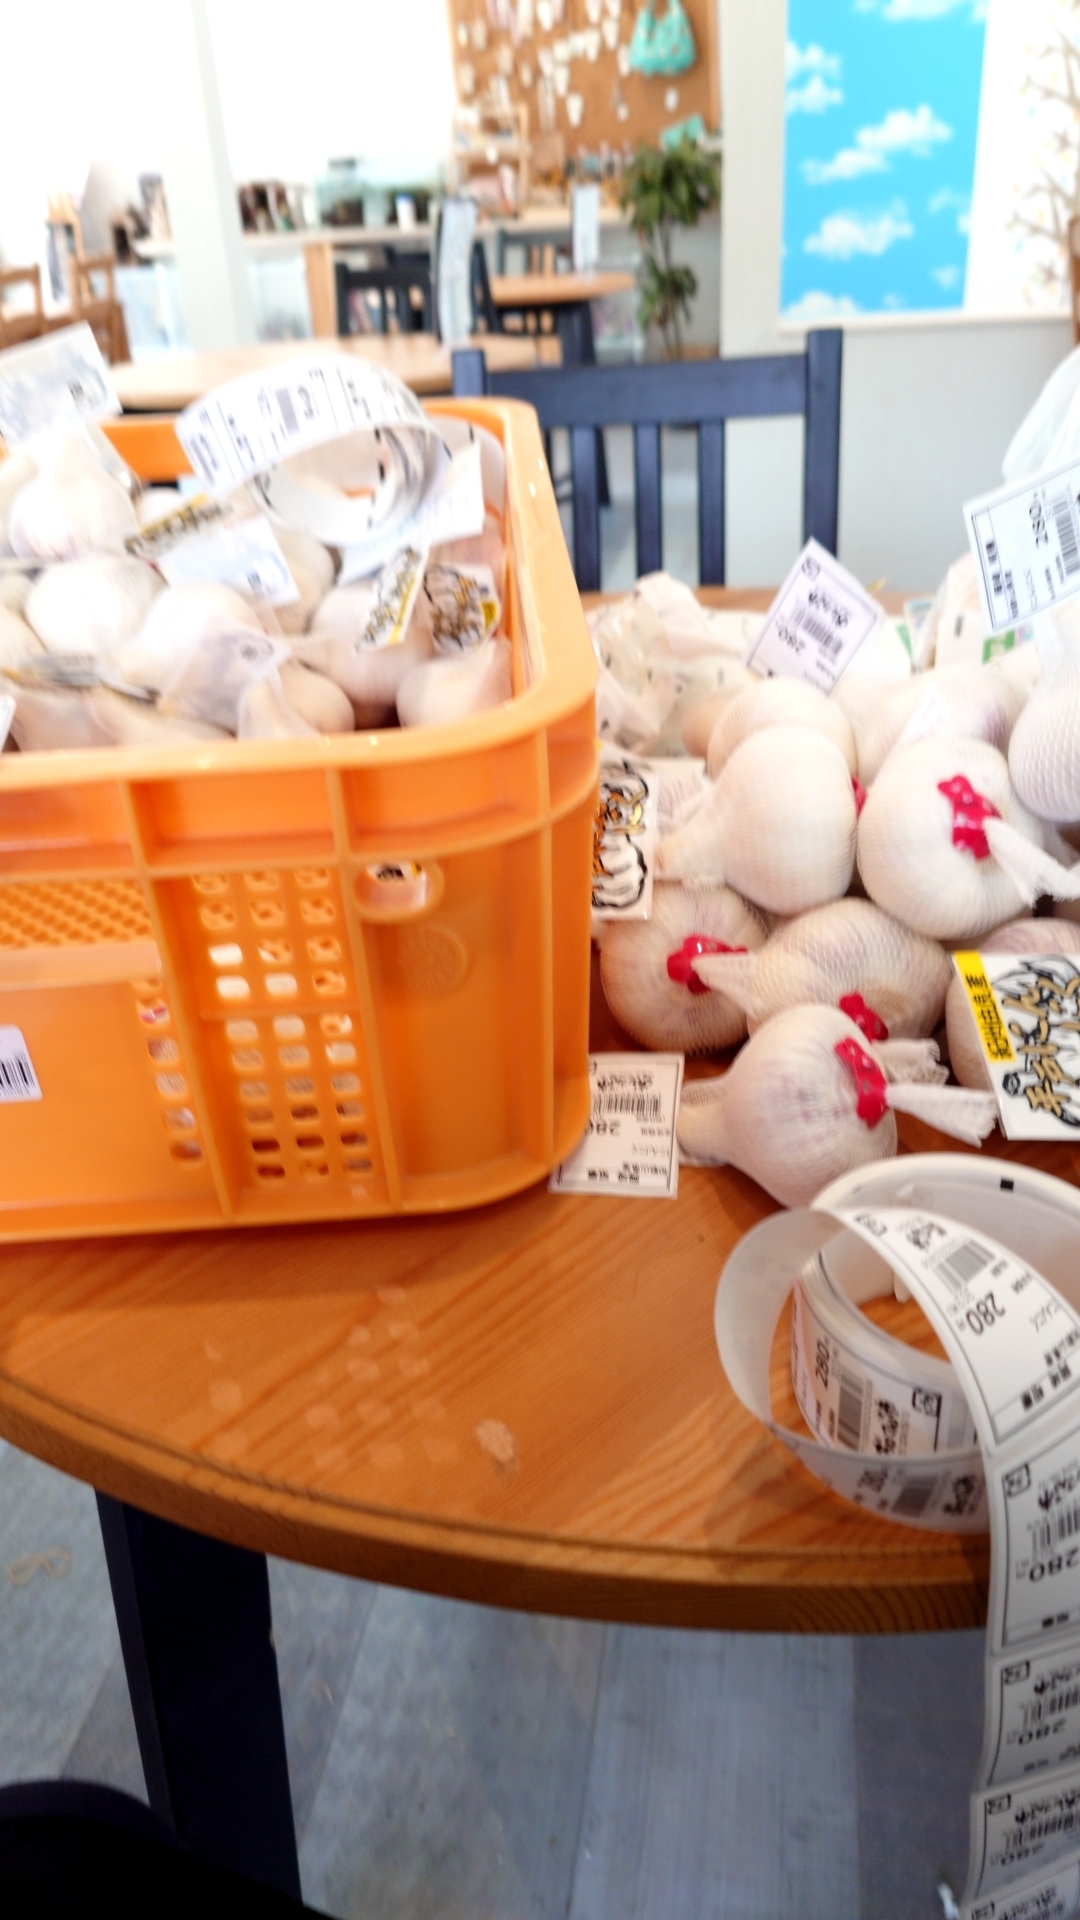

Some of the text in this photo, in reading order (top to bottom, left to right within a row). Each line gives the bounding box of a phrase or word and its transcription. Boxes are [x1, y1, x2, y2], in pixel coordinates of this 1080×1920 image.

[1028, 500, 1049, 550] 280
[965, 1291, 1006, 1335] 280
[815, 1337, 831, 1390] 280
[1028, 1545, 1080, 1583] 280
